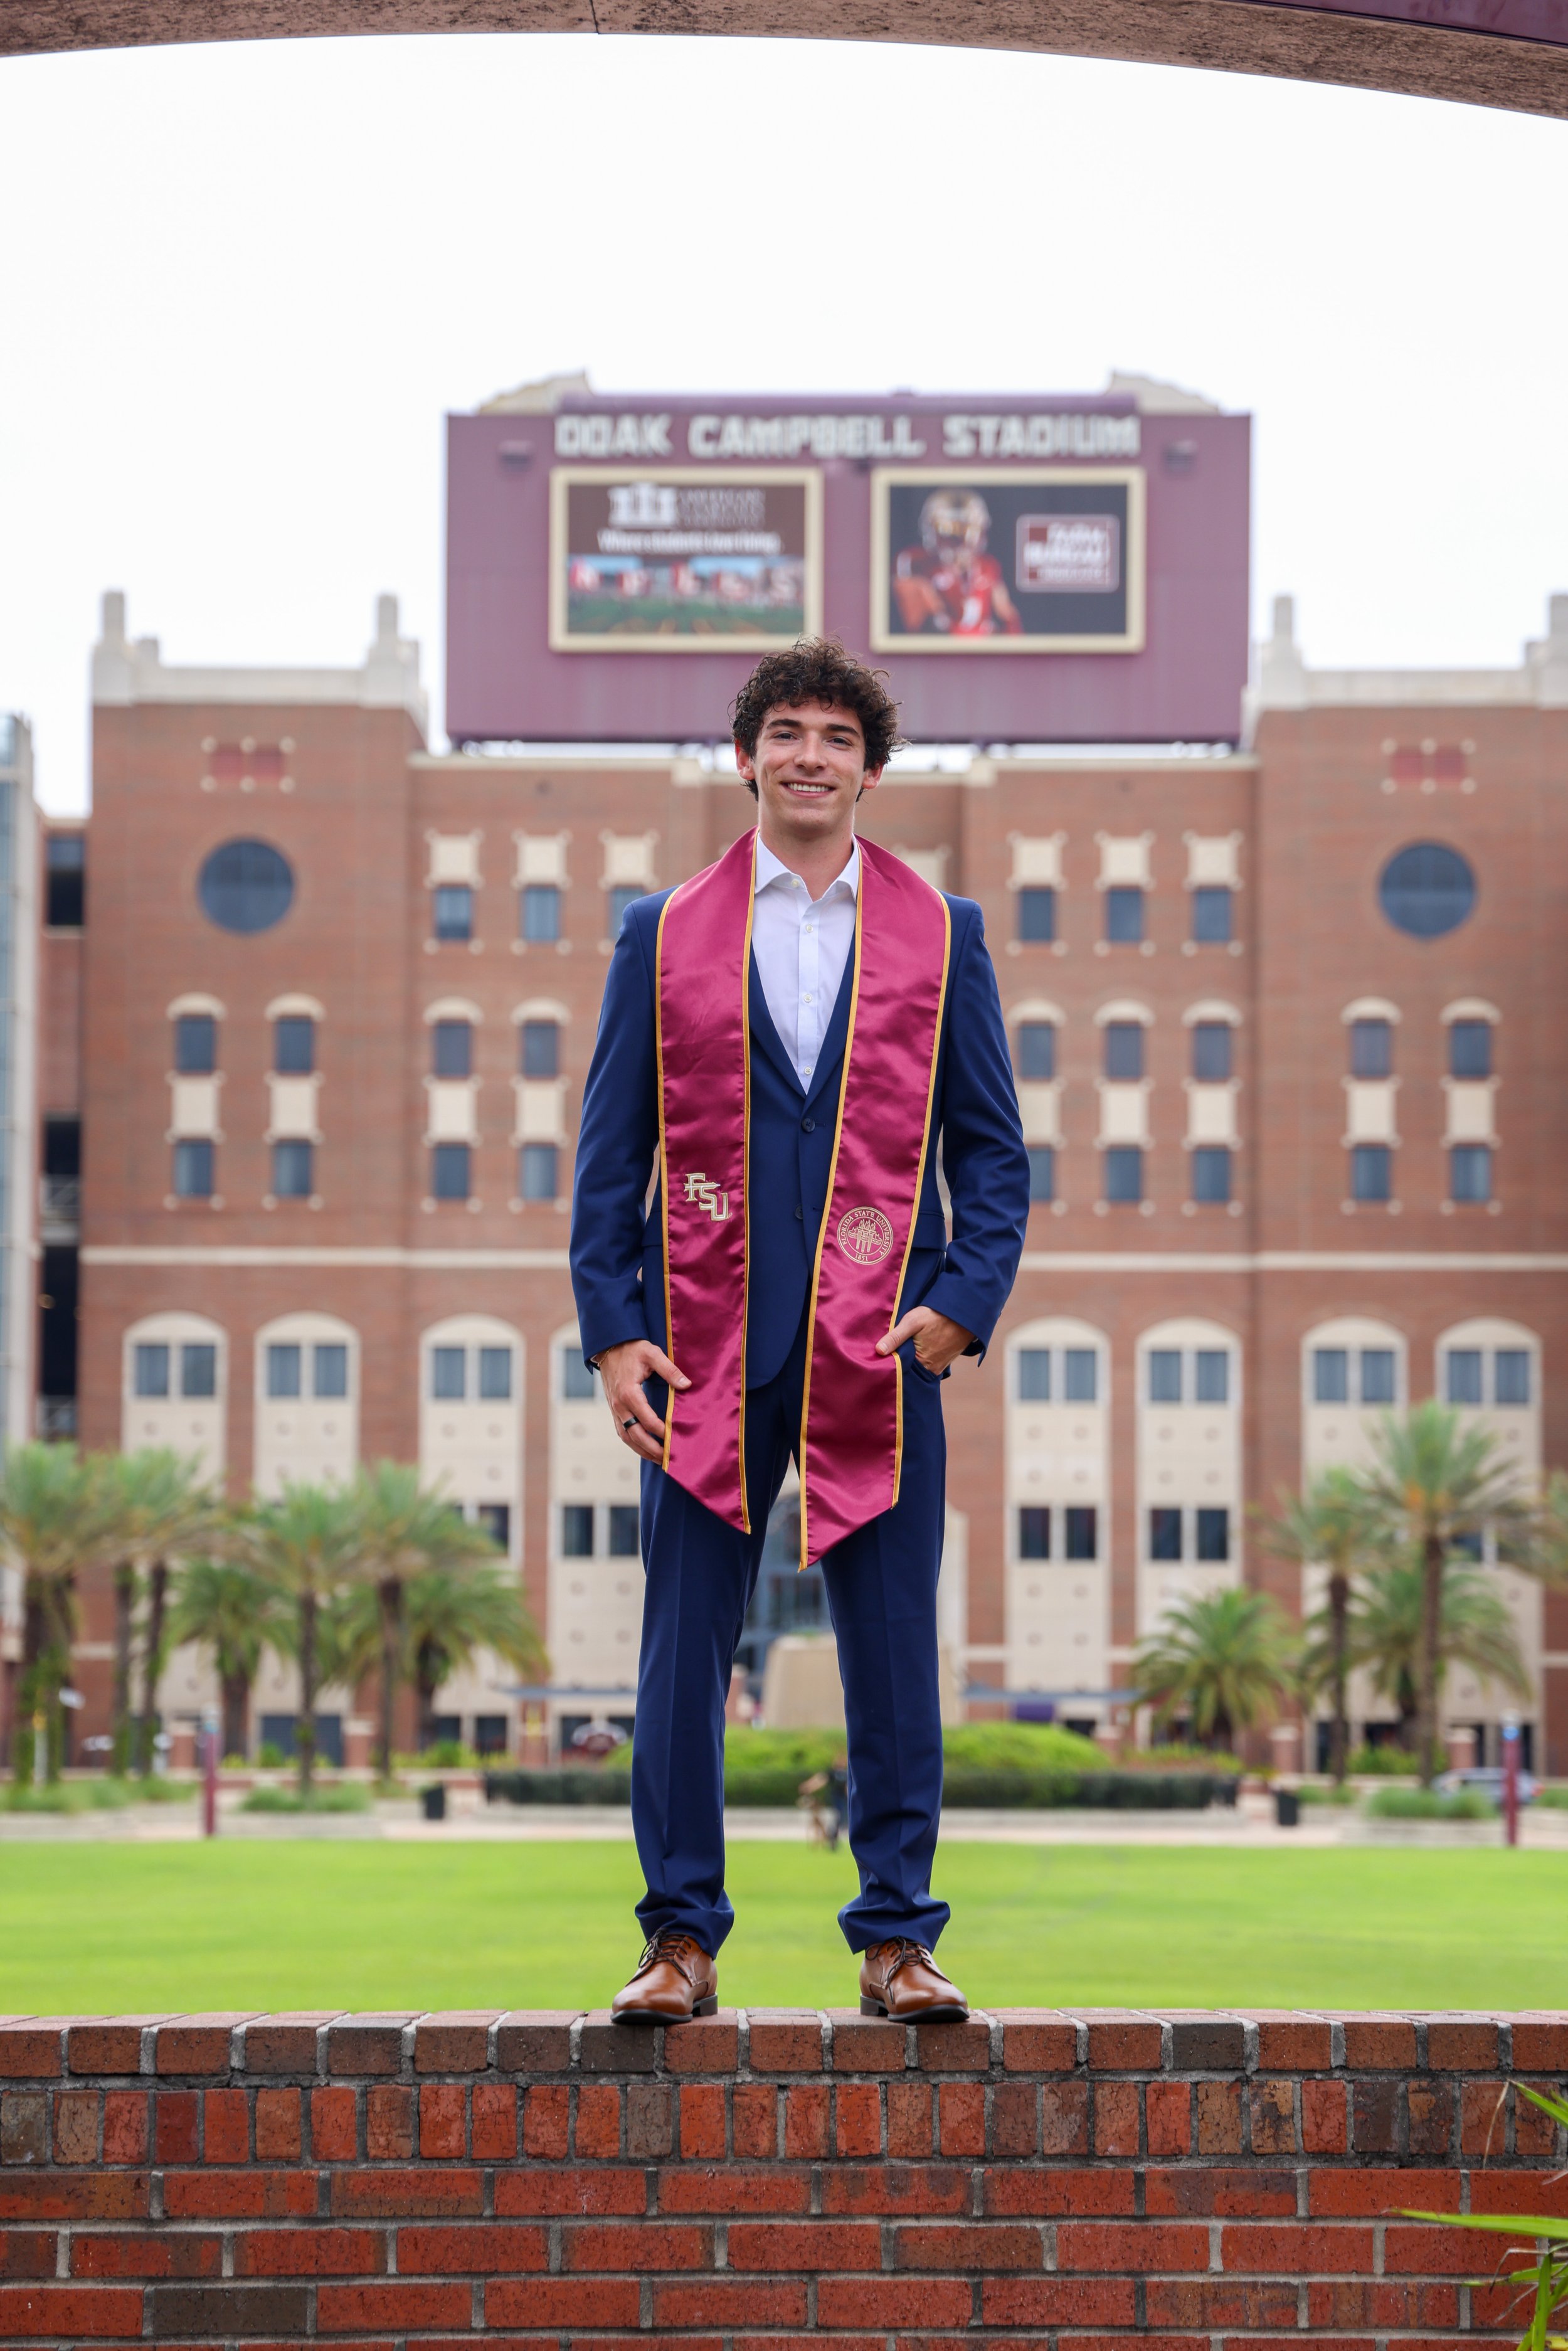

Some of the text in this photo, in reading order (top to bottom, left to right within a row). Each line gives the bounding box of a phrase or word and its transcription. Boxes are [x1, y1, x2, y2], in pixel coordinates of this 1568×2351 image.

[554, 414, 1141, 459] DOAK CAMPBELL STADIUM
[683, 1172, 728, 1221] FSU
[840, 1216, 854, 1246] FLORIDA
[876, 1215, 890, 1256] UNIVERSITY
[855, 1253, 869, 1261] 1851
